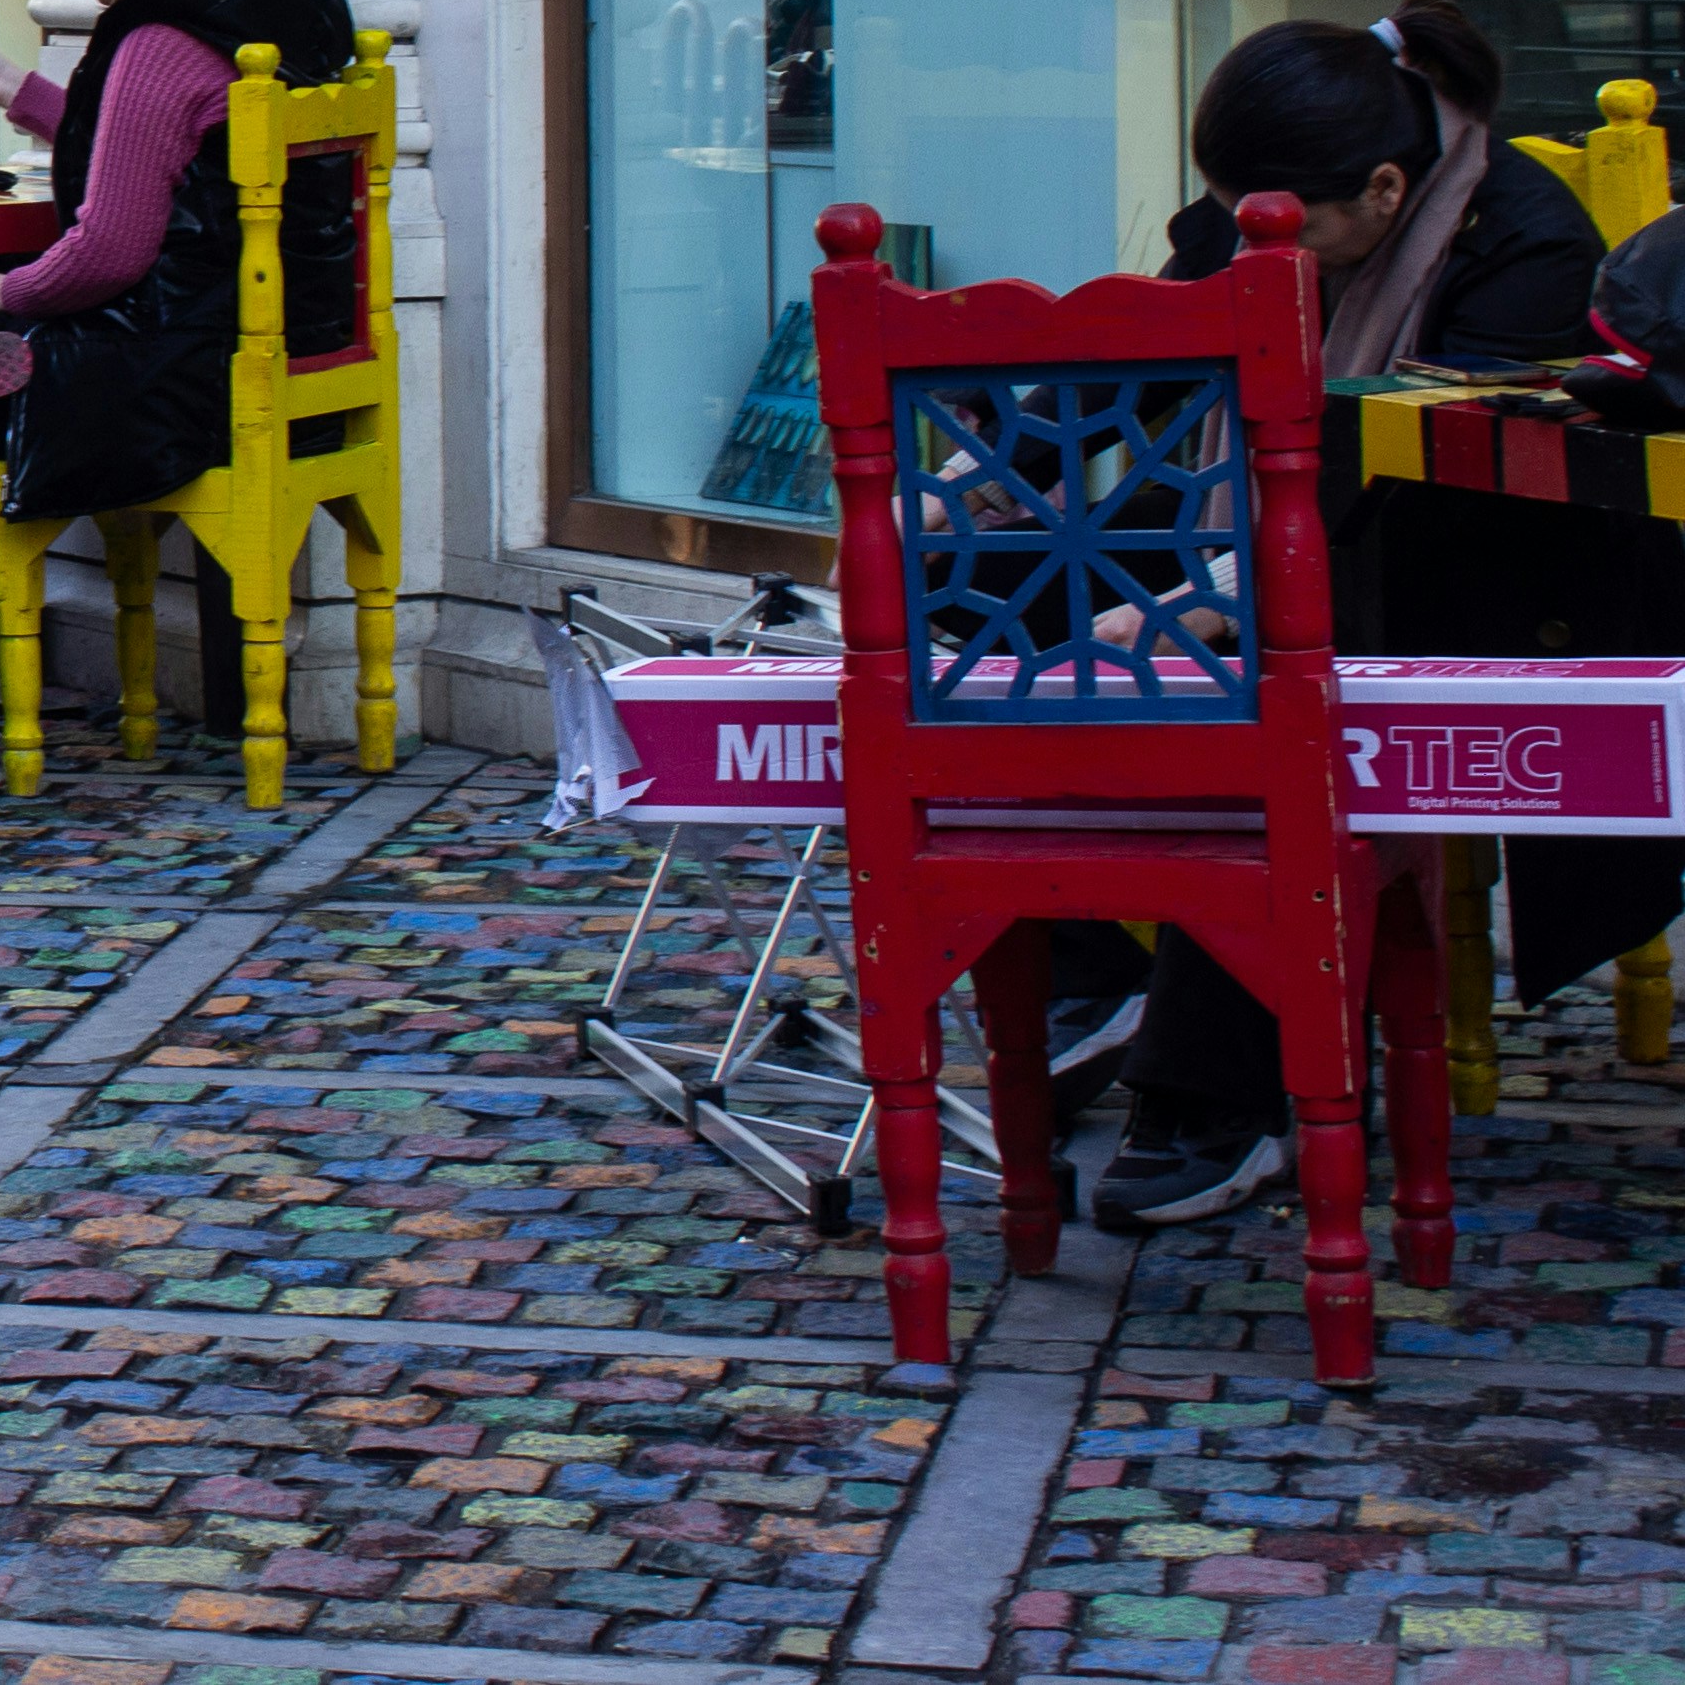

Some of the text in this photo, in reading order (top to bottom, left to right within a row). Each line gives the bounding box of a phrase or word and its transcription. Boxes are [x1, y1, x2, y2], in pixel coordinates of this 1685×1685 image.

[1333, 662, 1585, 677] RTEC
[716, 724, 844, 782] MIR
[1341, 726, 1562, 792] RTEC
[1407, 796, 1561, 811] Digital Printing Solutions
